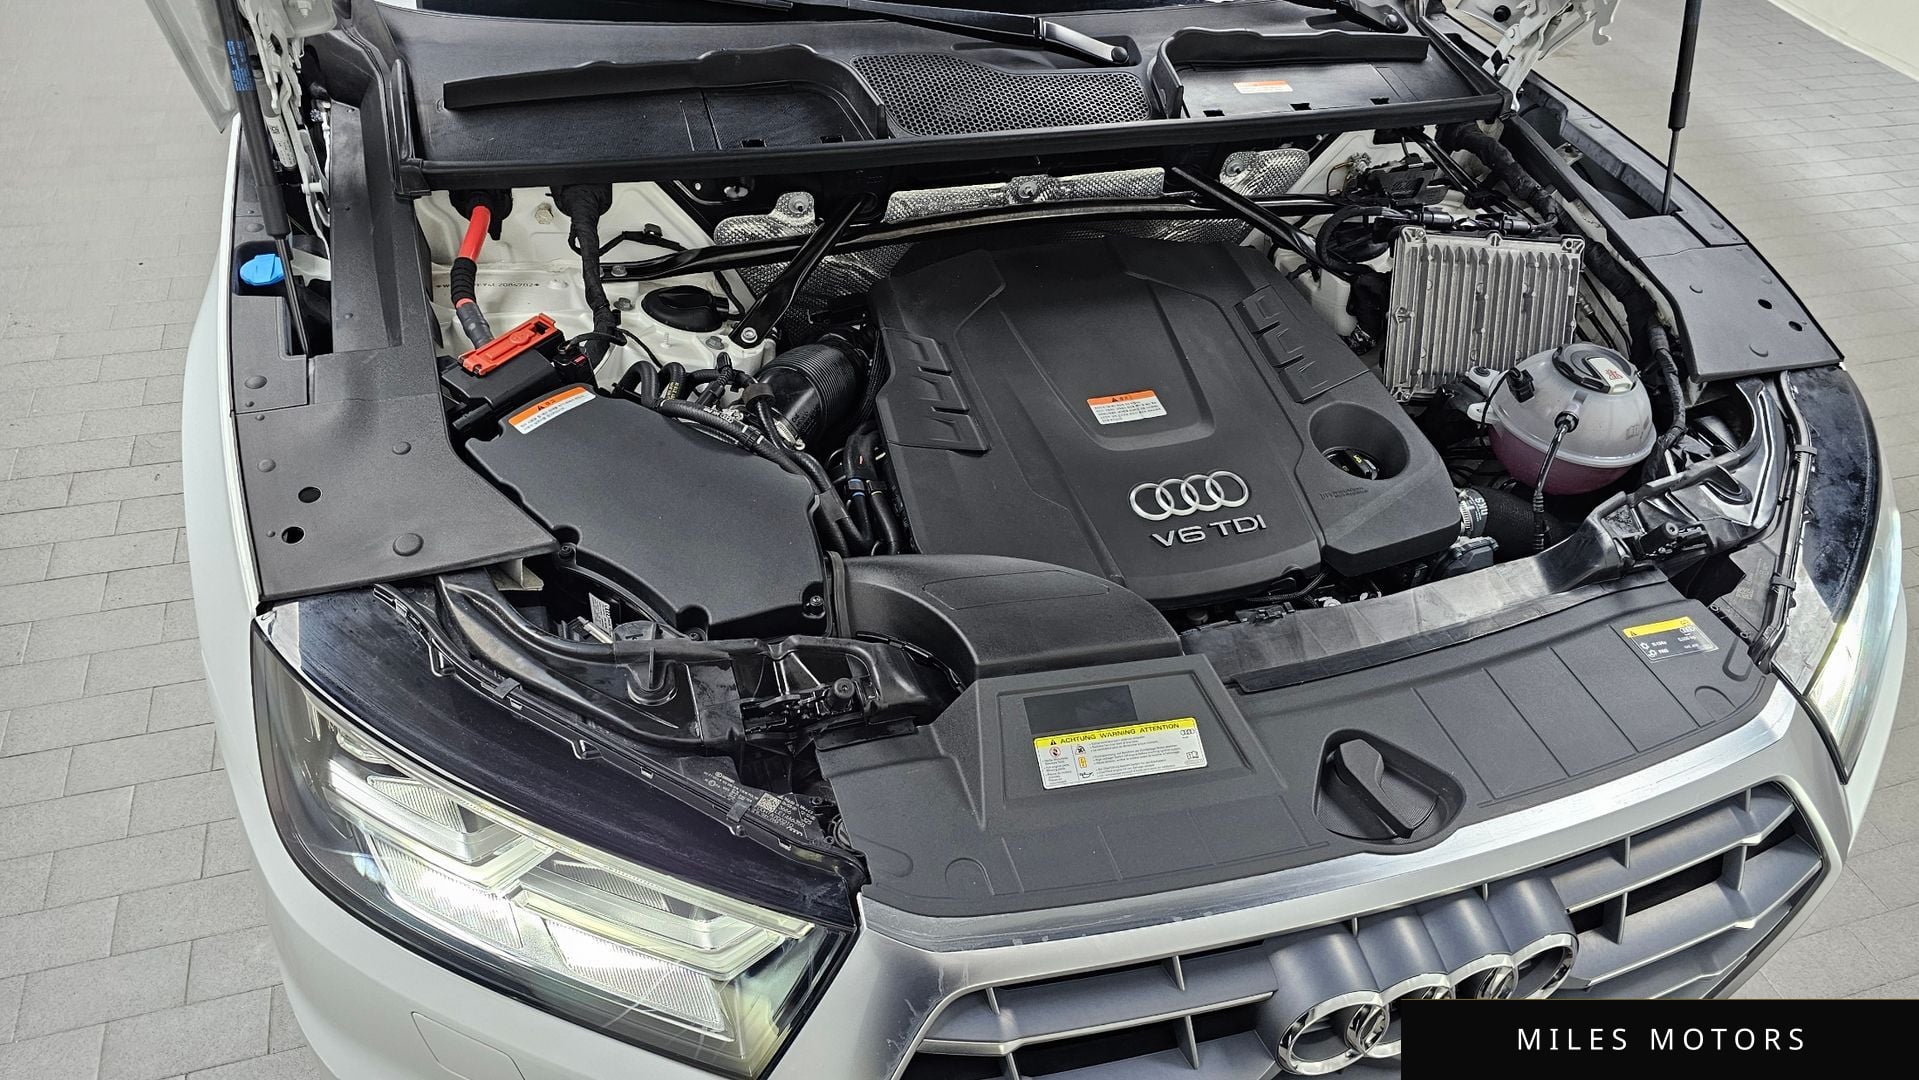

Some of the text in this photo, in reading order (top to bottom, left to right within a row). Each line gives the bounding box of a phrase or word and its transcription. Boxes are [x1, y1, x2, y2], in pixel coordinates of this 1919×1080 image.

[1151, 514, 1267, 547] V6 TDI
[1060, 722, 1180, 744] ACHTUNG WARNING ATTENTION
